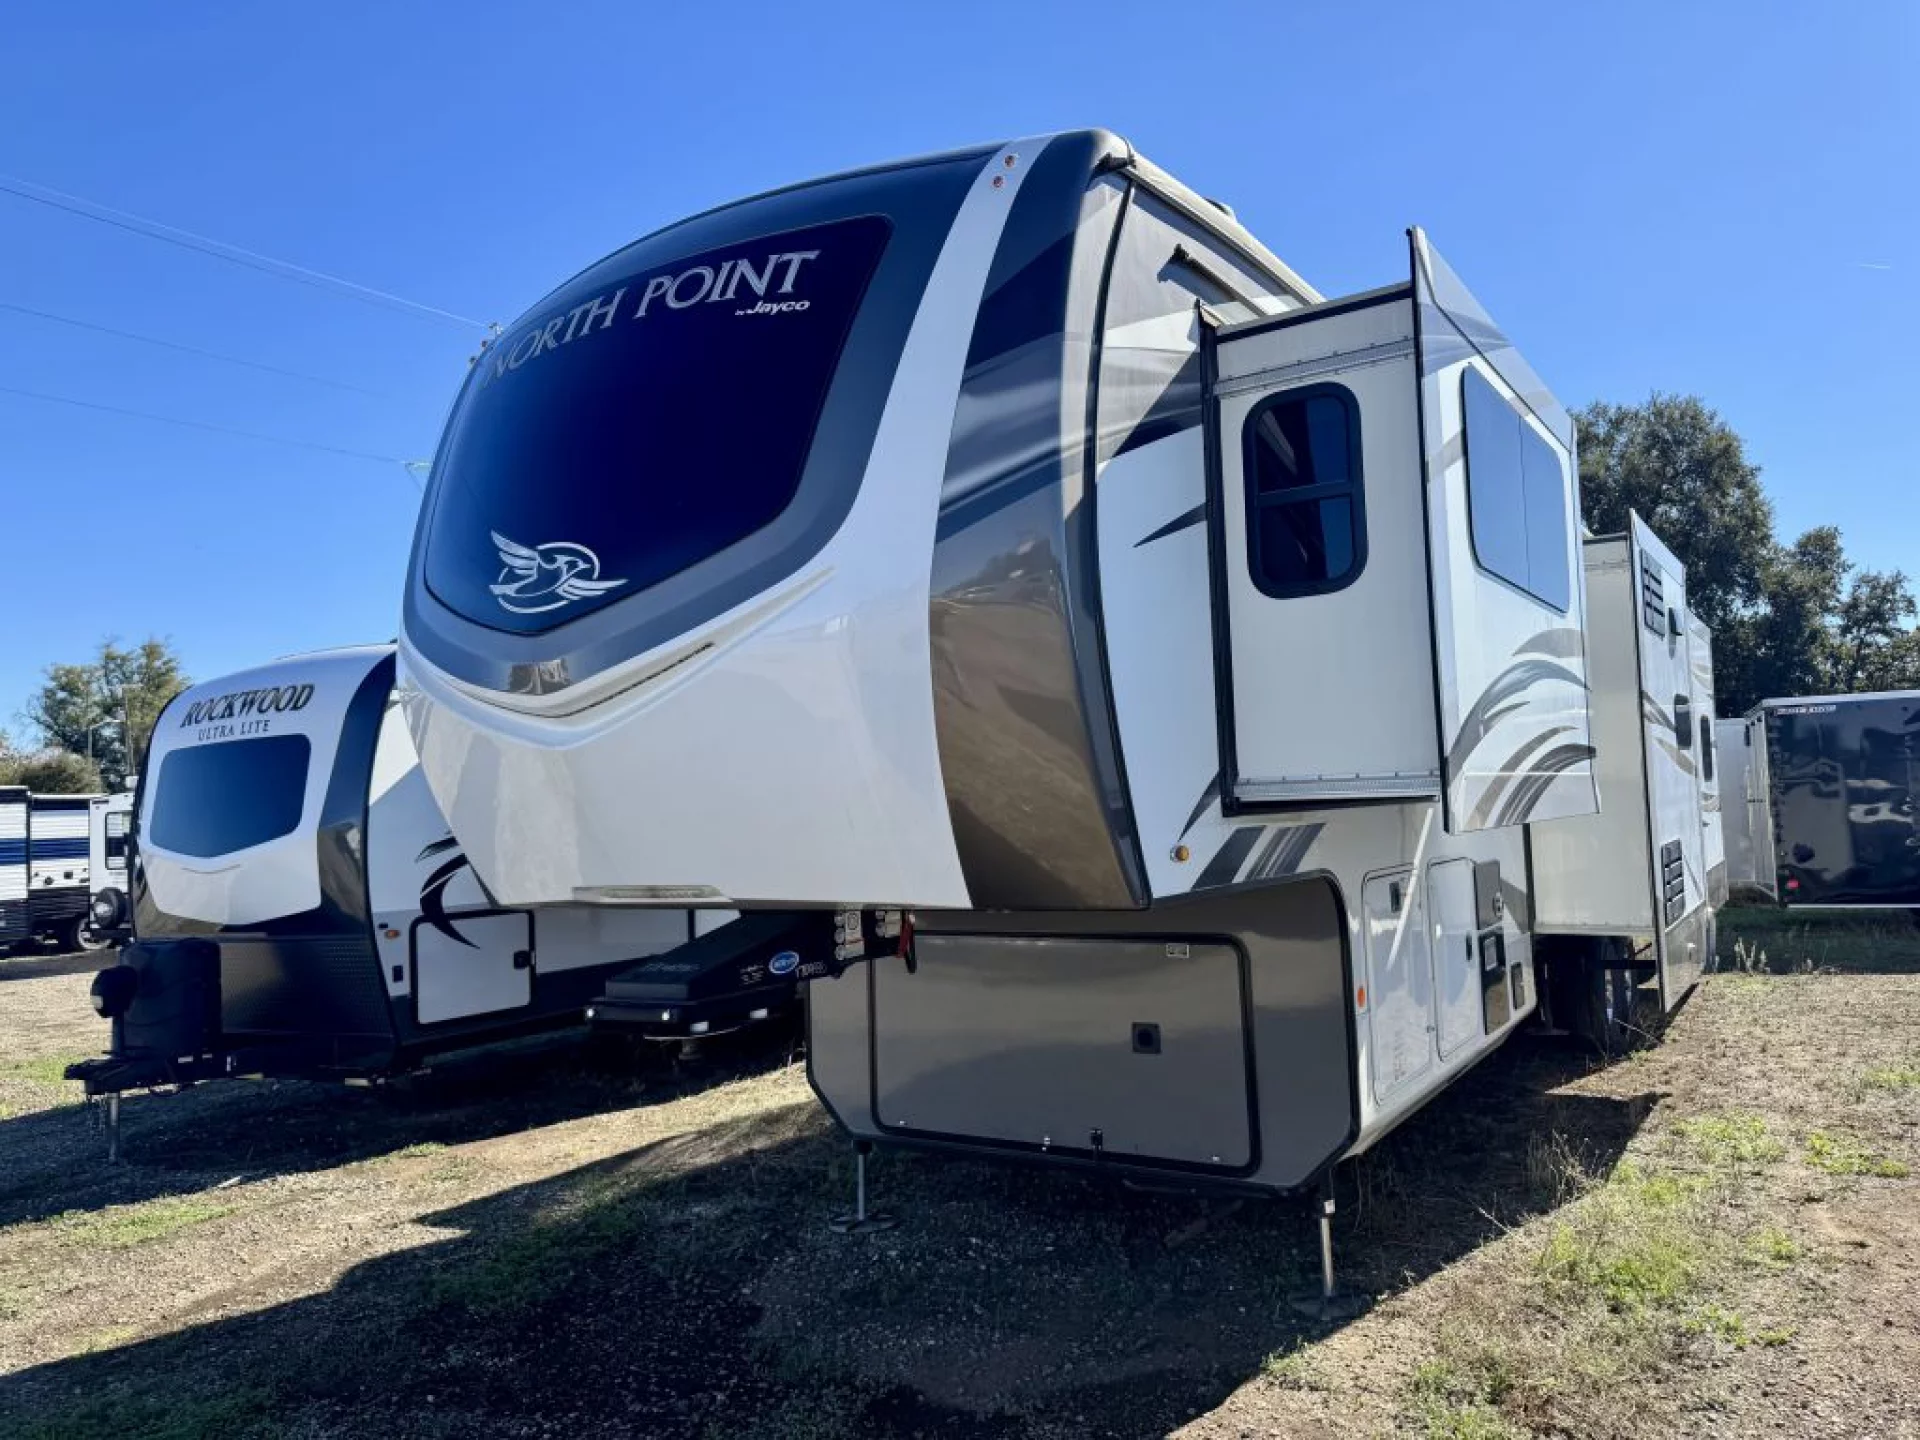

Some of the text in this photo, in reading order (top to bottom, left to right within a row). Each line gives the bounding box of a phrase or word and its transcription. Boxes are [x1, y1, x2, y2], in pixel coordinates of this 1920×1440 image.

[483, 250, 821, 389] NORTH POINT
[746, 300, 810, 315] Jayco
[180, 683, 315, 728] ROCKWOOD
[198, 720, 270, 741] ULTRA LITE
